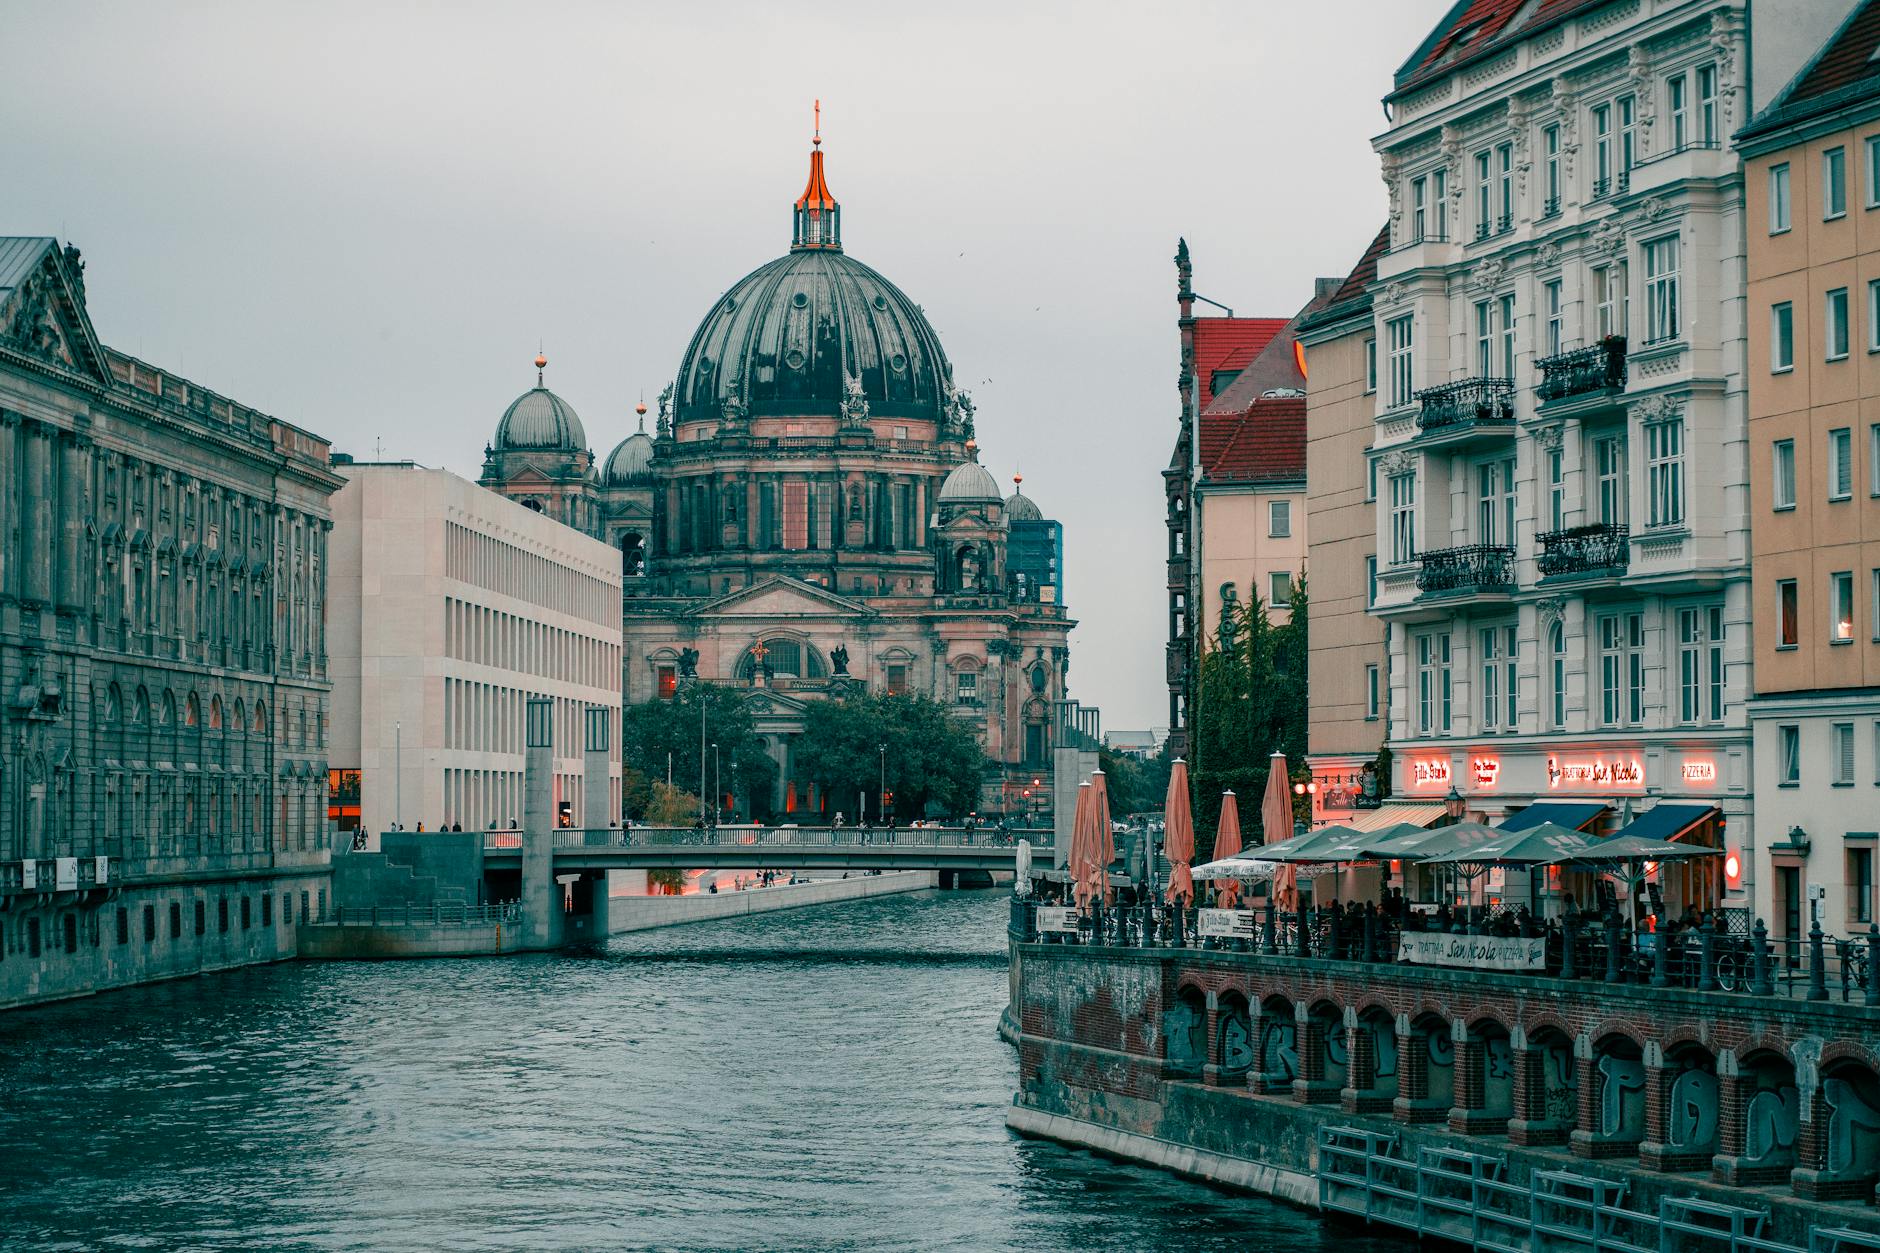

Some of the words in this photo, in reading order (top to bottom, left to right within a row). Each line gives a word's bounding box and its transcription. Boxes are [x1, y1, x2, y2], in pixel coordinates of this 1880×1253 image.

[1592, 763, 1608, 781] San
[1611, 761, 1639, 781] Nicola
[1682, 765, 1712, 778] PIZZERIA
[1447, 939, 1466, 959] San
[1467, 940, 1497, 961] Ncola
